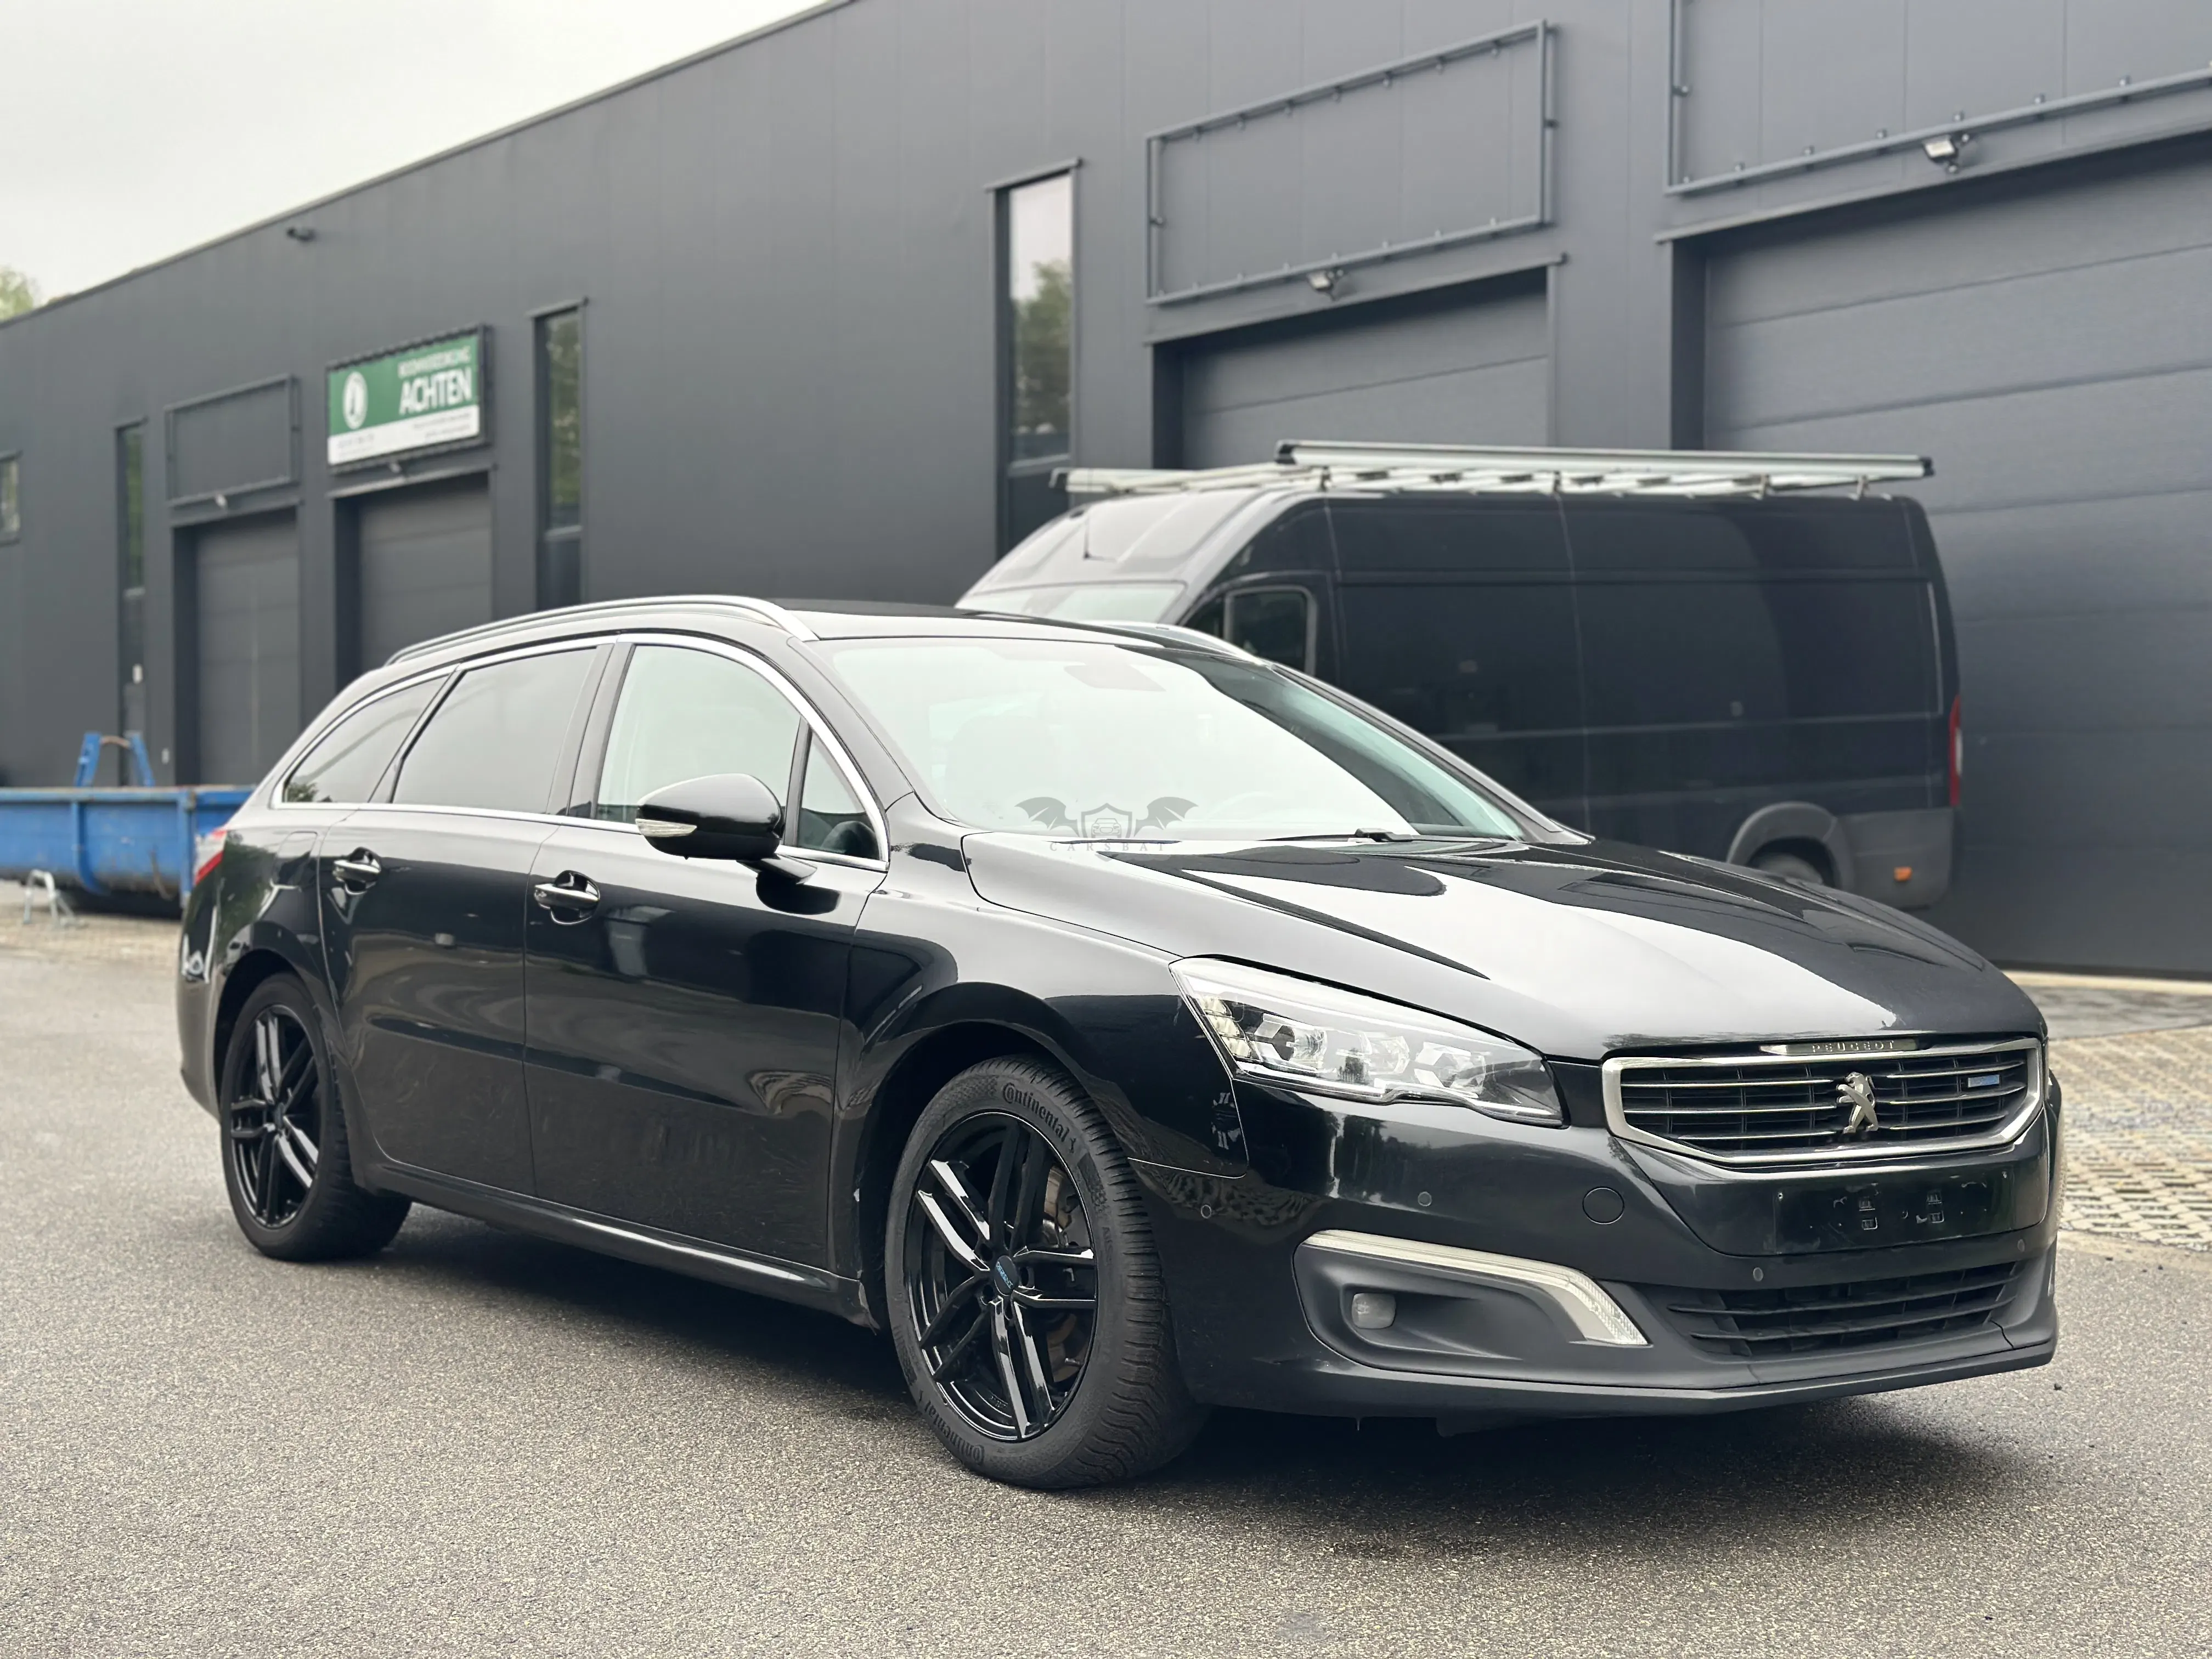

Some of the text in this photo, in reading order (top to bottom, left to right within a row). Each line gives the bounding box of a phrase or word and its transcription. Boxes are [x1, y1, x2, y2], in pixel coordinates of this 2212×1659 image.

[399, 366, 471, 415] ACHTEN
[1812, 1041, 1894, 1053] PEUGEOT
[1002, 1082, 1070, 1142] Continental
